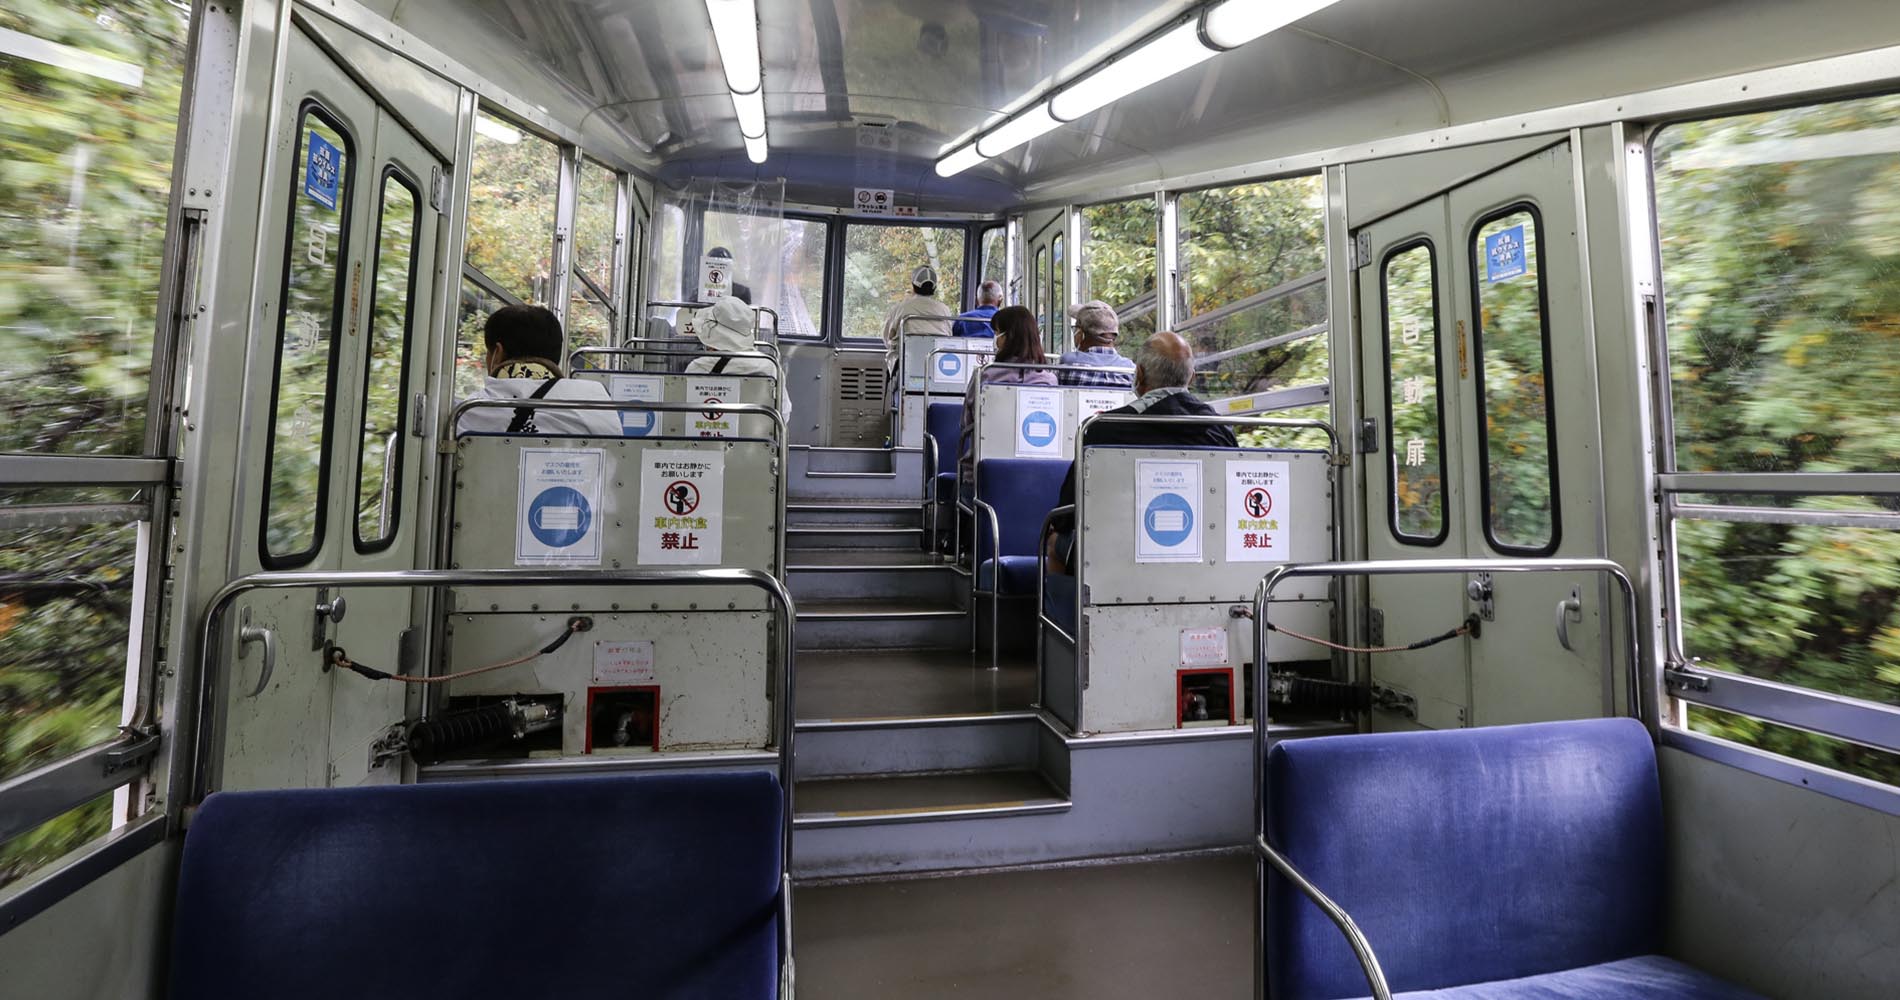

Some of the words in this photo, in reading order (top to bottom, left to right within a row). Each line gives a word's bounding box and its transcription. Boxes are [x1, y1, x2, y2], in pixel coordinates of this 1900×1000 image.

[1402, 318, 1427, 467] 自動扉
[654, 462, 711, 470] 車内ではお静かに
[654, 516, 708, 529] 車内飲食
[1238, 519, 1278, 530] 車内飲食
[661, 532, 699, 550] 禁止
[1243, 533, 1272, 548] 禁止
